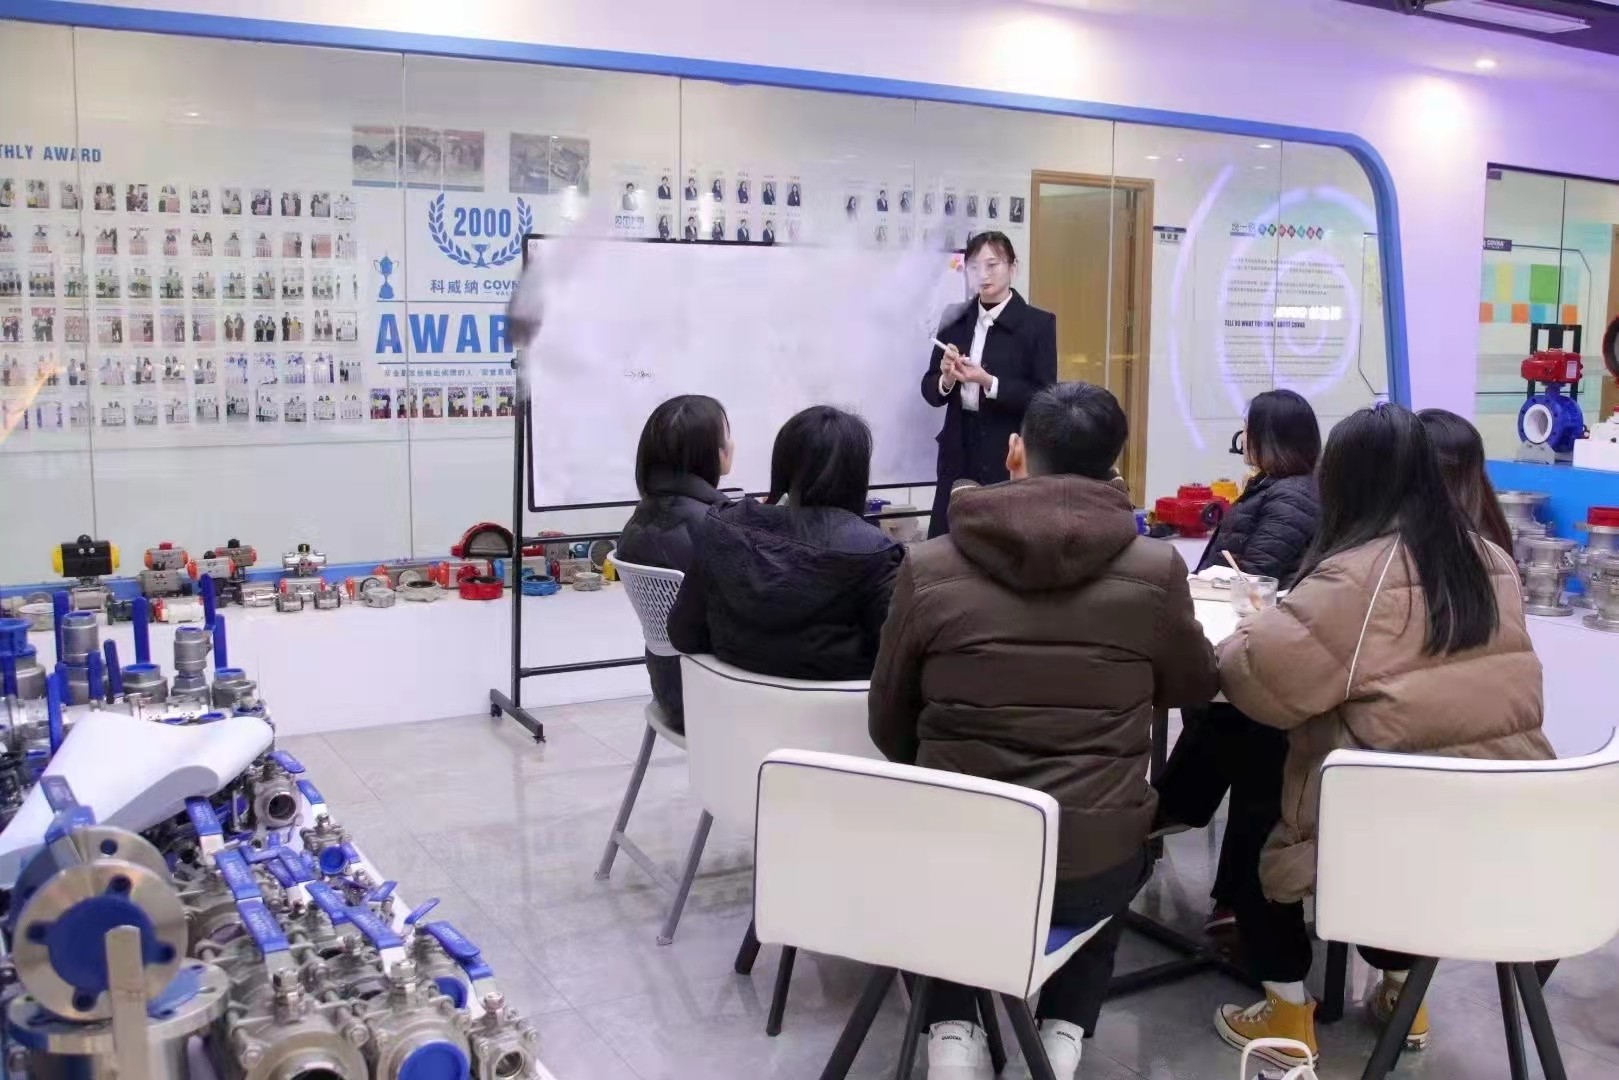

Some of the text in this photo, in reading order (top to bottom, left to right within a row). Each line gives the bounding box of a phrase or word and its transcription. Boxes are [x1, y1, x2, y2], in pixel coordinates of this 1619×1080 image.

[43, 146, 102, 162] AWARD
[454, 207, 511, 237] 2000
[483, 279, 521, 290] COVN
[375, 313, 514, 354] AWAR
